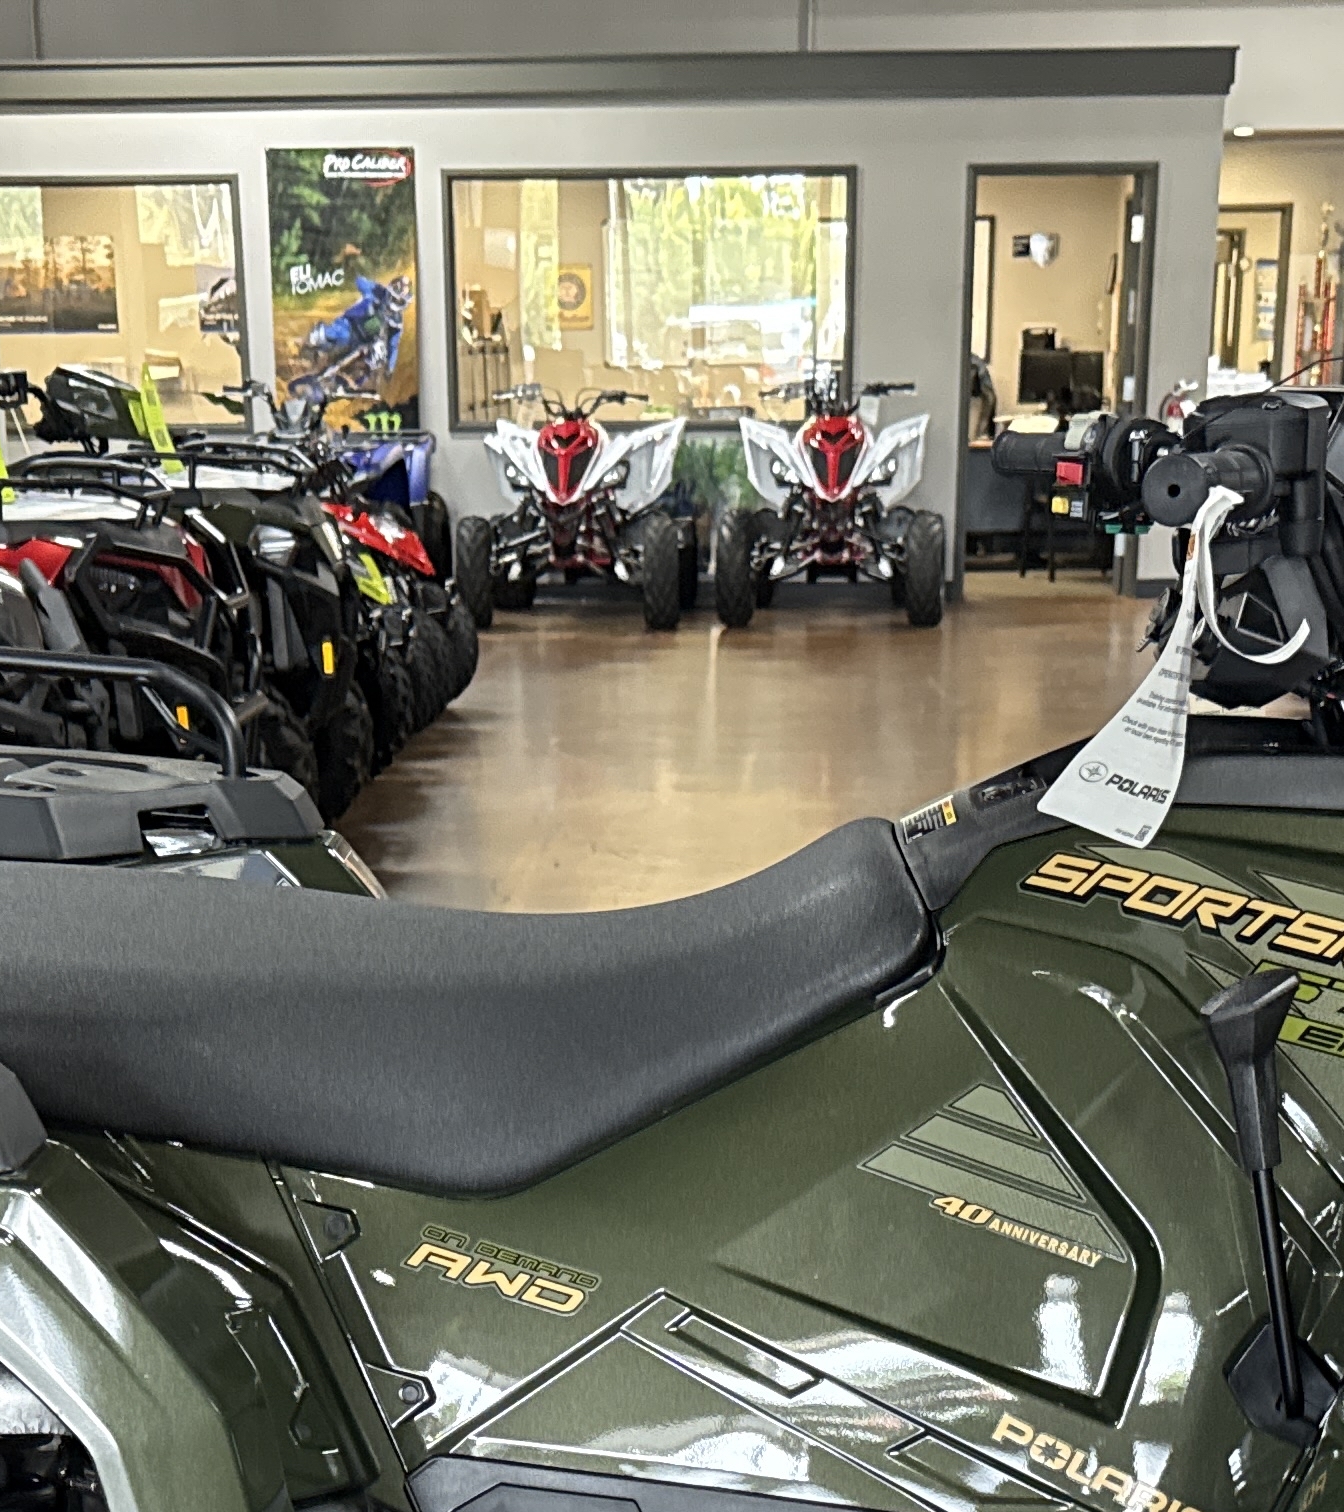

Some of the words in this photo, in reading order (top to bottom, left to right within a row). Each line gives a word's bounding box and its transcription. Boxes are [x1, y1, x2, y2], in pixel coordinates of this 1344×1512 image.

[291, 268, 345, 295] TOMAC
[1105, 773, 1172, 805] POLARIS
[421, 1224, 469, 1249] ON
[473, 1241, 600, 1291] DEMAND
[931, 1195, 994, 1226] 40
[988, 1218, 1103, 1269] ANNIVERSARY
[405, 1241, 586, 1315] AWD
